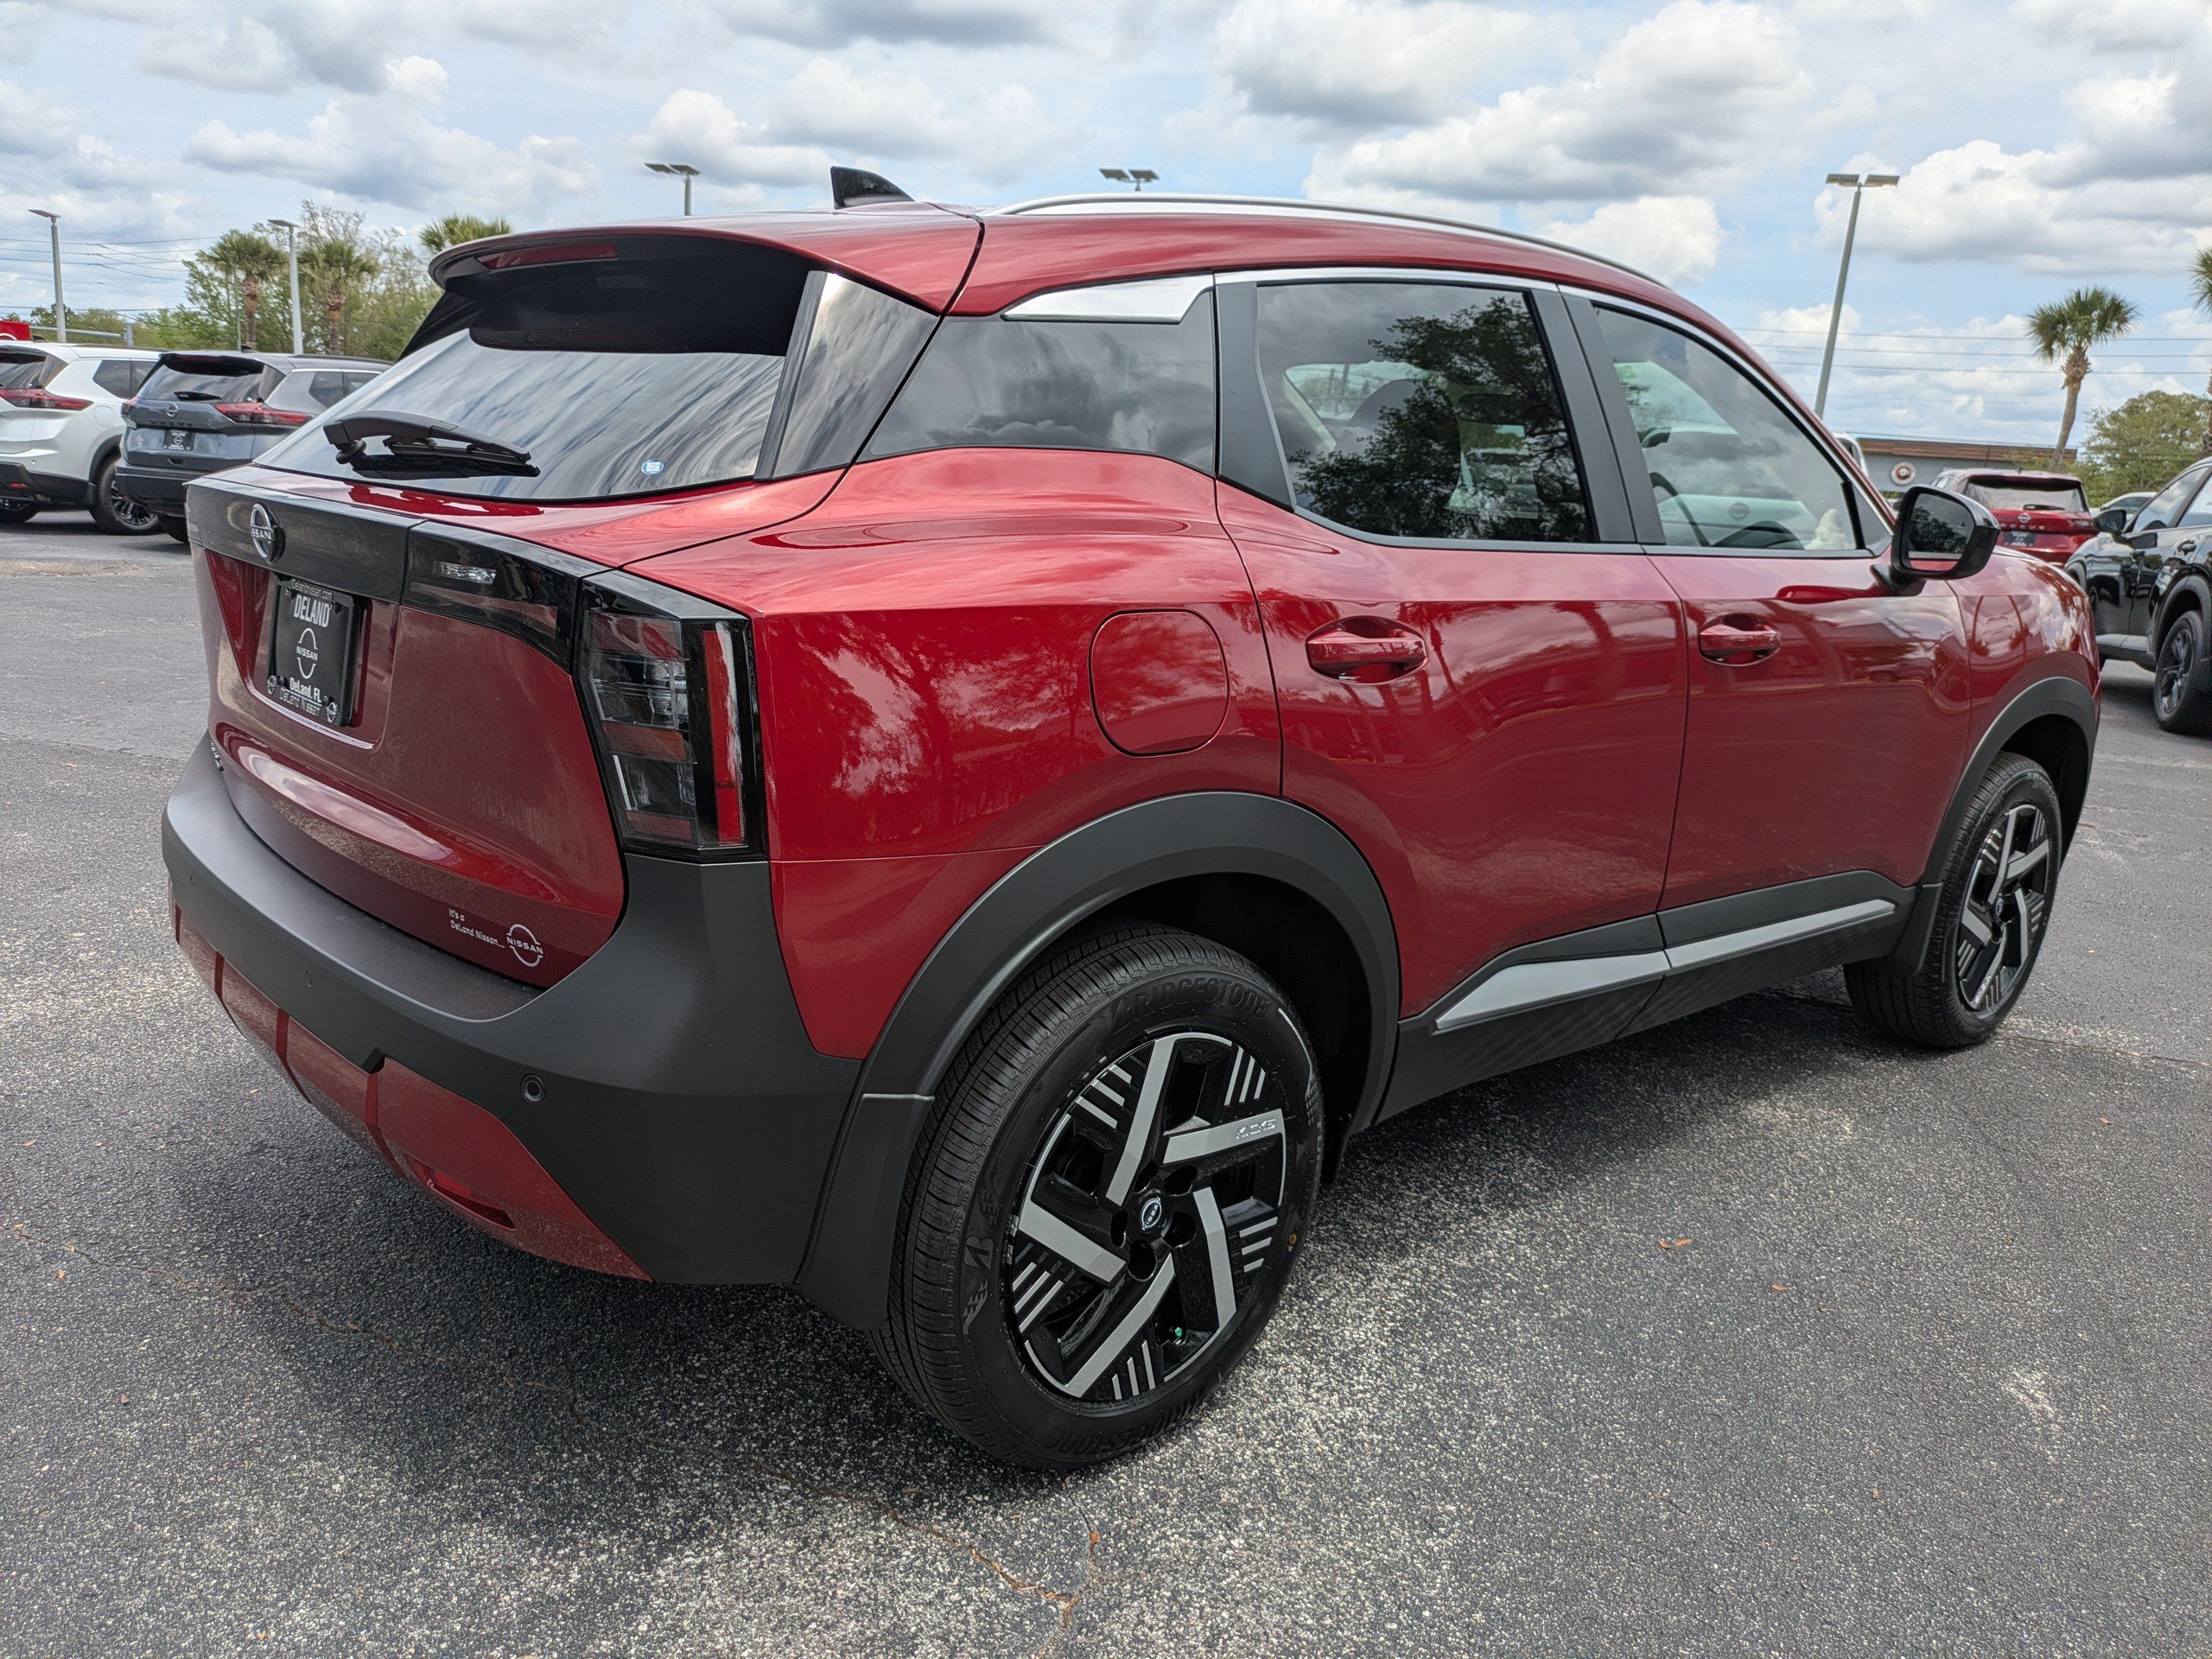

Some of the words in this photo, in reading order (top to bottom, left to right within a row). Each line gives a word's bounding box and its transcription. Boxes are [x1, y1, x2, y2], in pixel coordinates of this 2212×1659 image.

[293, 594, 330, 628] DELAND
[296, 645, 318, 661] NISSAN
[313, 687, 322, 703] FL
[448, 907, 459, 918] It's
[449, 919, 474, 936] DeLand
[506, 936, 543, 955] NISSAN
[1111, 977, 1271, 1035] BRIDGESTONE
[1236, 1118, 1276, 1140] KICKS
